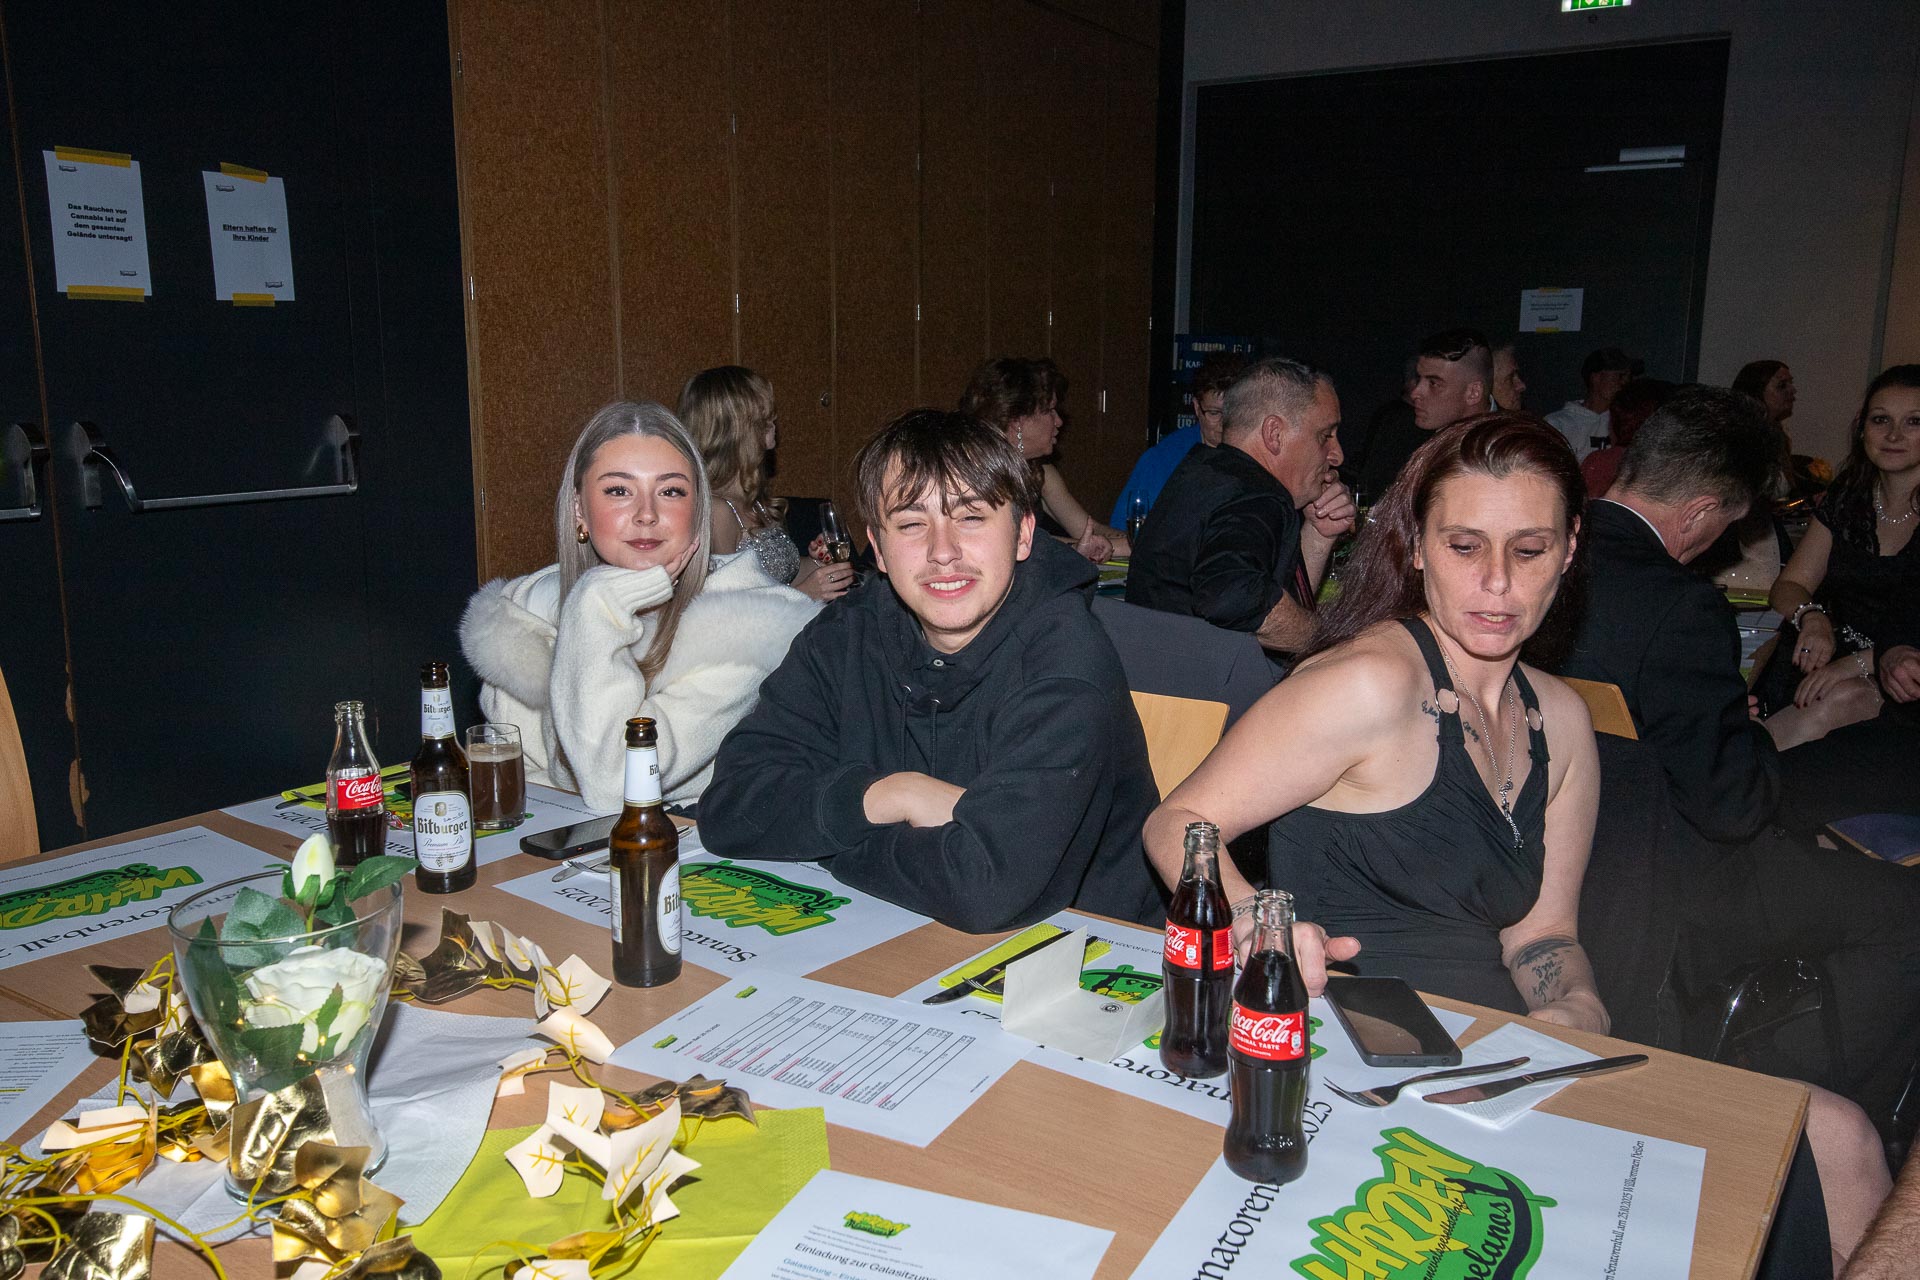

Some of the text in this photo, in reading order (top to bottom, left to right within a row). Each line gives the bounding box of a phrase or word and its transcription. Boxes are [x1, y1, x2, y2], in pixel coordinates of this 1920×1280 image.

[70, 212, 104, 221] Cannabis
[83, 205, 114, 213] Rauchen
[67, 230, 97, 239] Gelände
[91, 224, 125, 232] gesamten
[222, 223, 244, 232] Eltern
[244, 225, 266, 233] haften
[247, 234, 270, 243] Kinder
[423, 703, 452, 714] Bitburger
[649, 764, 659, 776] Bit
[417, 817, 468, 835] Bitburger
[0, 868, 197, 929] WEHRD
[663, 892, 681, 915] Bit
[1231, 1006, 1295, 1044] Coca-Cola
[1233, 1032, 1281, 1051] ORIGINAL TASTE
[1623, 1158, 1642, 1193] Willkommen
[794, 1242, 849, 1266] Einladung
[849, 1258, 868, 1270] zur
[783, 1256, 833, 1278] Galasitzung
